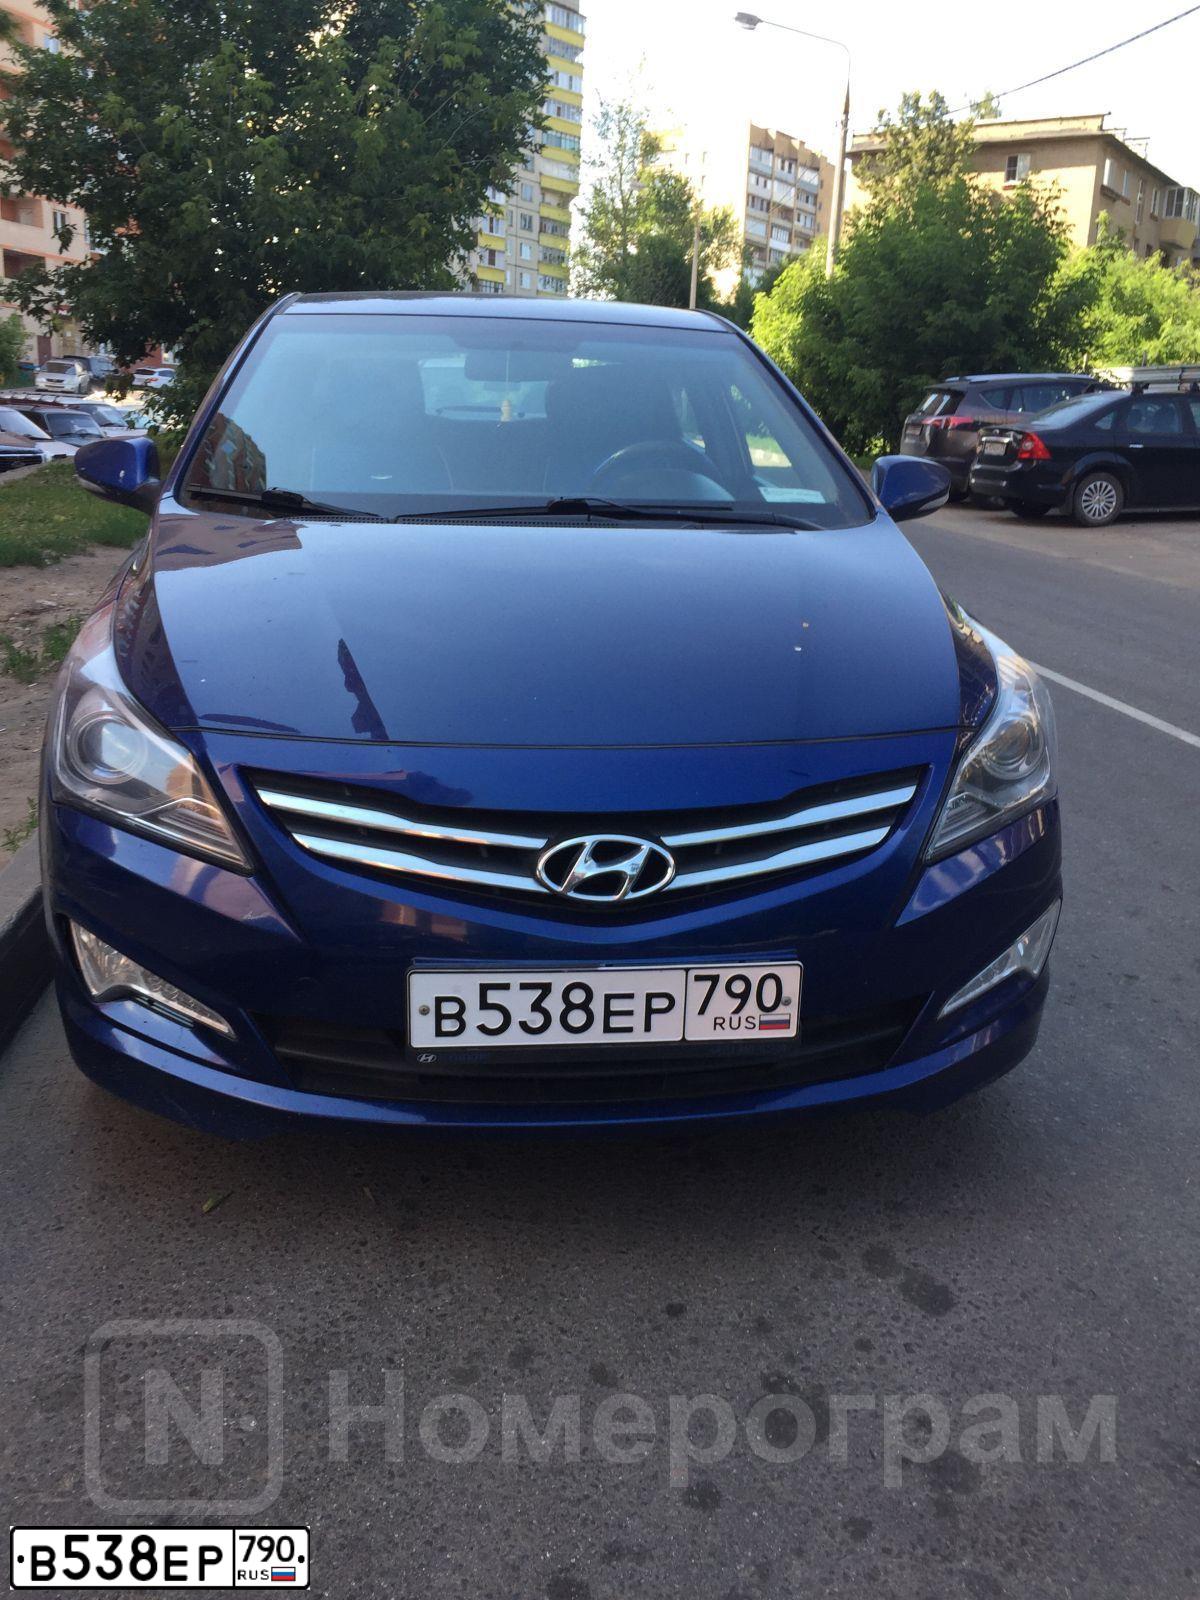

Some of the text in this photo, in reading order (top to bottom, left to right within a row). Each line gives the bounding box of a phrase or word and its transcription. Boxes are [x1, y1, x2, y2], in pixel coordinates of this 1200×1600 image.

[434, 973, 783, 1037] В538ЕР 790
[713, 1015, 757, 1031] RUS
